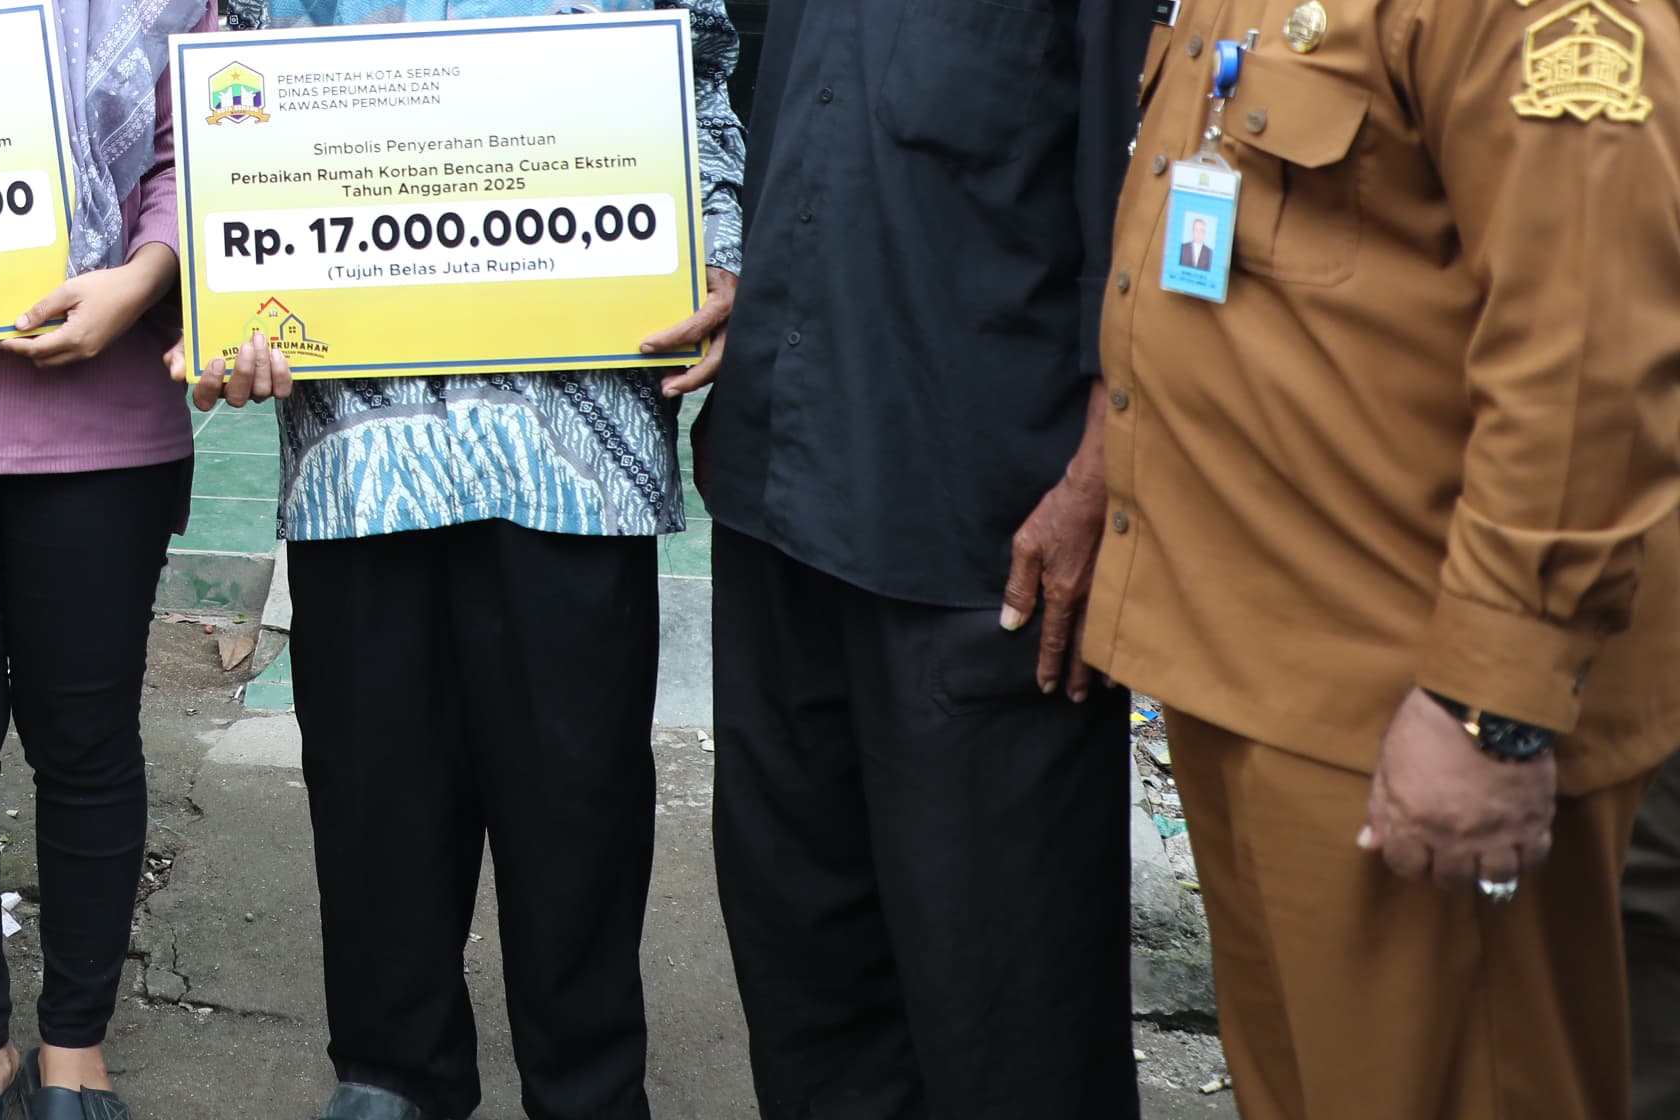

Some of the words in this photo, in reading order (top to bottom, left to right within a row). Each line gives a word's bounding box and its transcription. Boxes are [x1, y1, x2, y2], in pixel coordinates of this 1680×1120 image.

[278, 72, 362, 84] PEMERINTAH
[366, 70, 402, 81] KOTA
[407, 66, 461, 78] SERANG
[278, 87, 319, 98] DINAS
[322, 82, 407, 96] PERUMAHAN
[411, 81, 440, 92] DAN
[279, 99, 348, 112] KAWASAN
[352, 95, 441, 108] PERMUKIMAN
[313, 140, 381, 156] Simbolis
[386, 137, 483, 154] Penyerahan
[489, 134, 556, 148] Bantuan
[231, 170, 312, 185] Perbaikan
[317, 167, 373, 180] Rumah
[379, 165, 438, 179] Korban
[444, 160, 513, 175] Bencana
[519, 158, 569, 172] Cuaca
[575, 154, 637, 169] Ekstrim
[342, 183, 392, 197] Tahun
[398, 181, 478, 196] Anggaran
[483, 177, 526, 191] 2025
[223, 221, 295, 265] Rp.
[308, 203, 657, 254] 17.000.000,00
[328, 265, 383, 280] (Tujuh
[389, 263, 436, 276] Belas
[443, 261, 480, 275] Juta
[487, 257, 555, 273] Rupiah)
[222, 347, 239, 357] BID
[267, 342, 329, 353] ERUMAHAN
